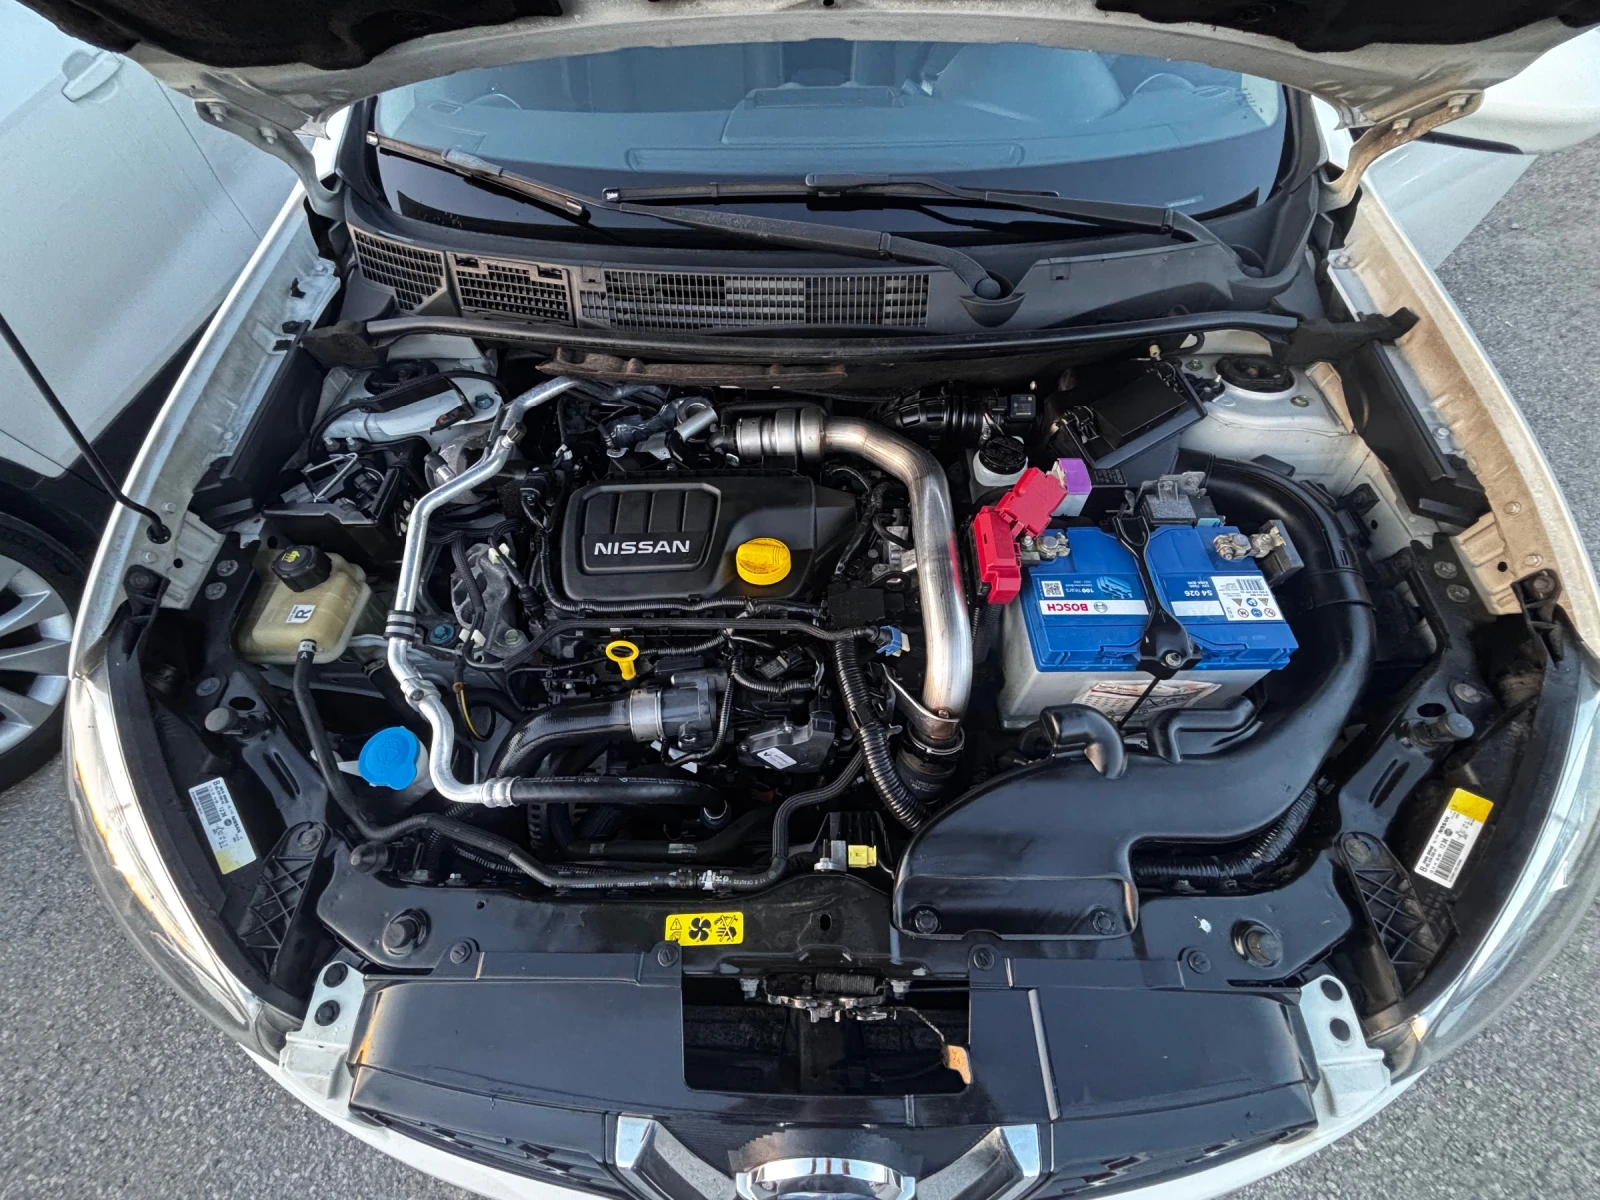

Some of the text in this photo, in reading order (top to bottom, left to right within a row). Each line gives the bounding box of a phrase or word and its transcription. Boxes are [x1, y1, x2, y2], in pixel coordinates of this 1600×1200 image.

[594, 540, 690, 555] NISSAN
[293, 609, 311, 618] R
[1047, 603, 1089, 612] BOSCH
[231, 816, 241, 833] NISSAN
[1438, 816, 1450, 834] NISSAN
